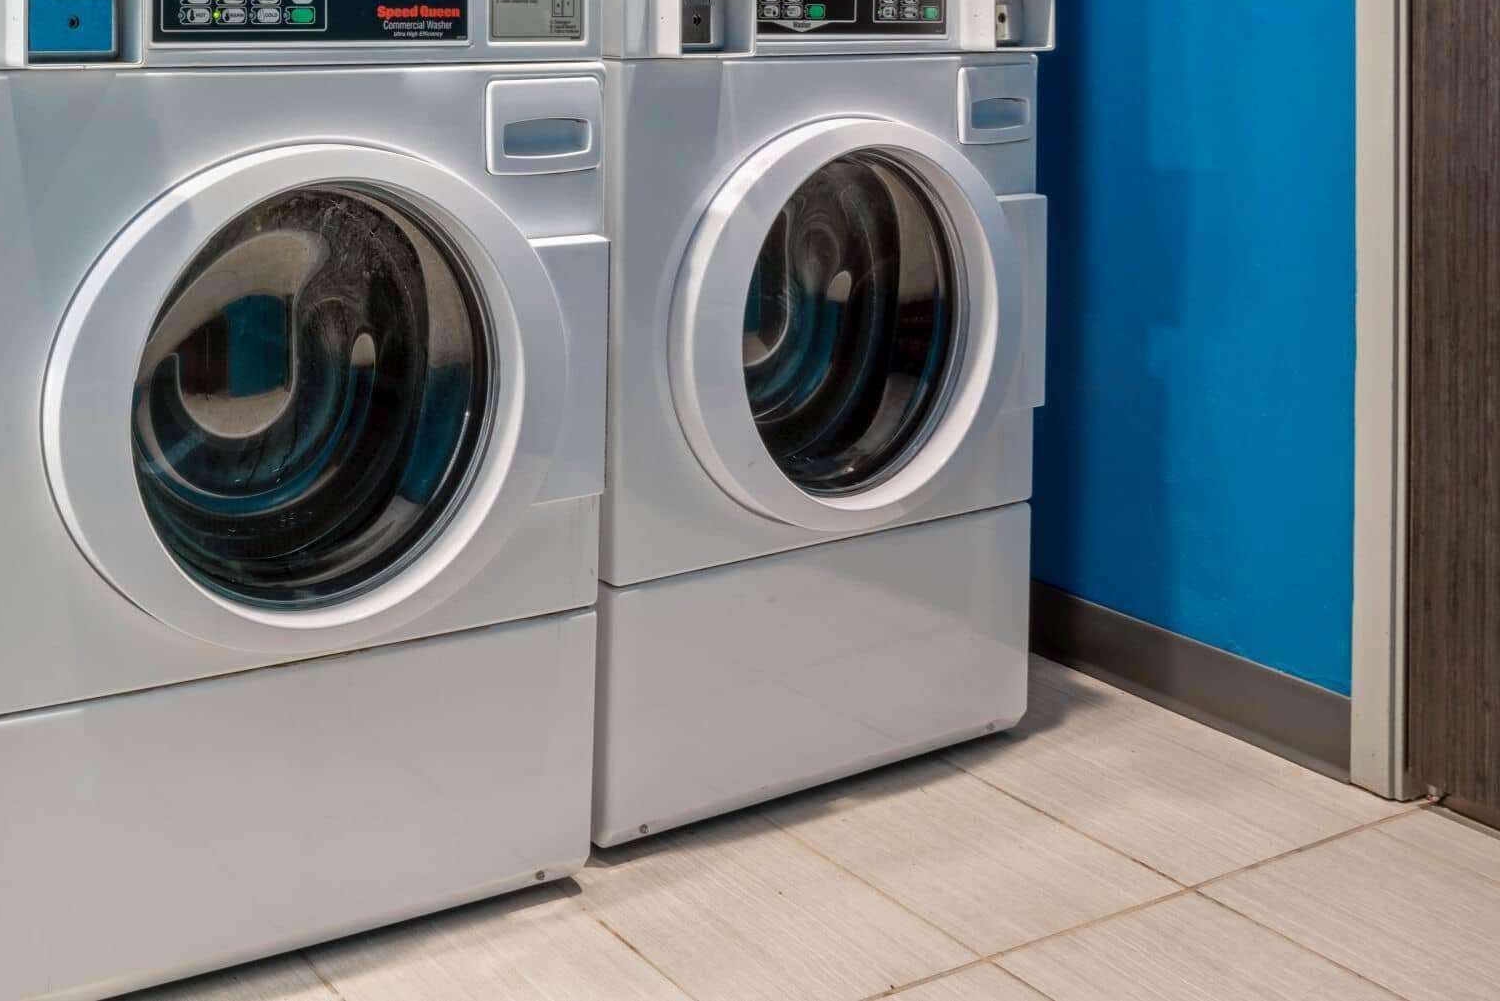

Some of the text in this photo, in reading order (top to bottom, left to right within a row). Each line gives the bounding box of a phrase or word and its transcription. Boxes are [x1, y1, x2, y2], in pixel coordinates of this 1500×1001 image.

[377, 5, 460, 20] Speed Queen
[383, 20, 453, 30] Commercial Washer
